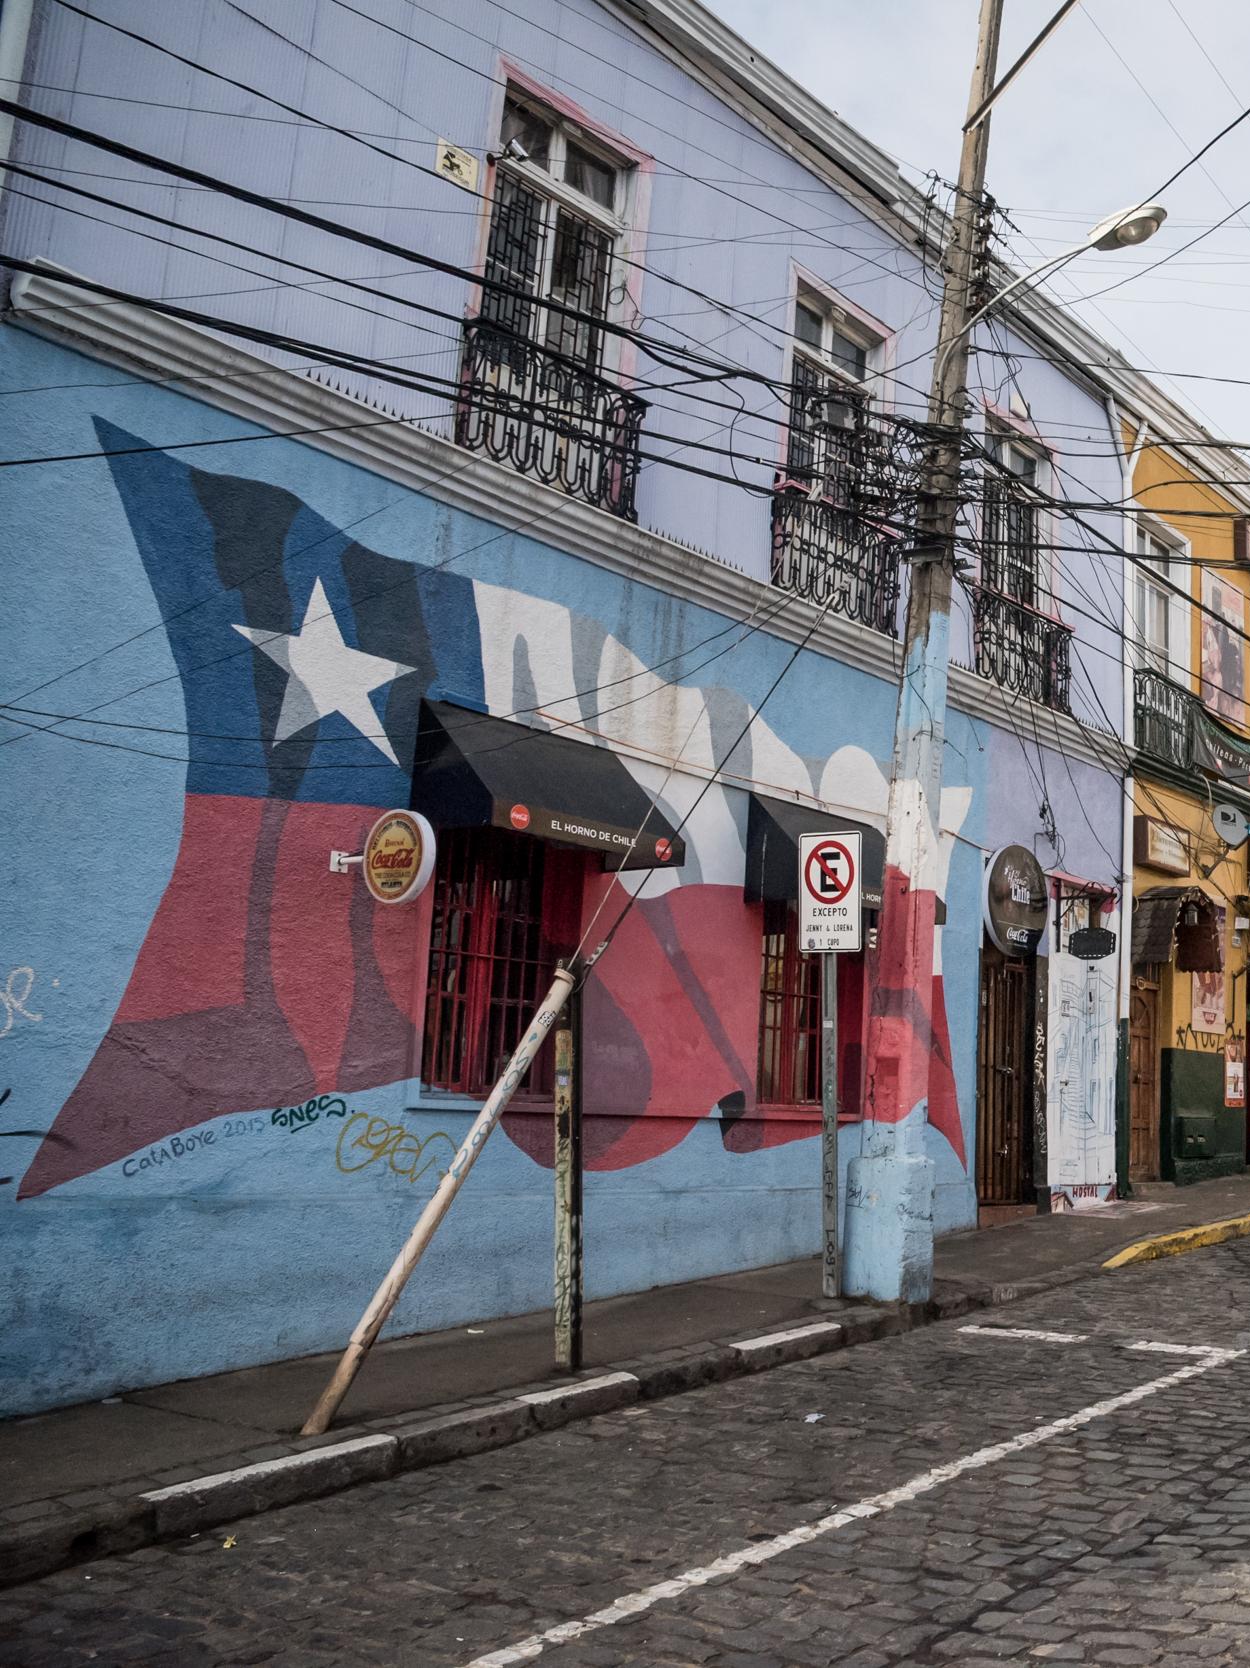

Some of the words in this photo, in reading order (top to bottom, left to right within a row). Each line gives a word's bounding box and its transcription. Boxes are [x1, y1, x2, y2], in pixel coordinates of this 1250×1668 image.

[551, 820, 562, 831] EL
[564, 824, 597, 839] HORNO
[599, 832, 611, 842] DE
[612, 835, 637, 848] CHILE
[1011, 883, 1030, 905] Chile
[812, 907, 848, 917] EXCEPTO
[806, 924, 822, 933] JENNY
[833, 924, 853, 932] LORENA
[1072, 1186, 1098, 1198] HOSTAL
